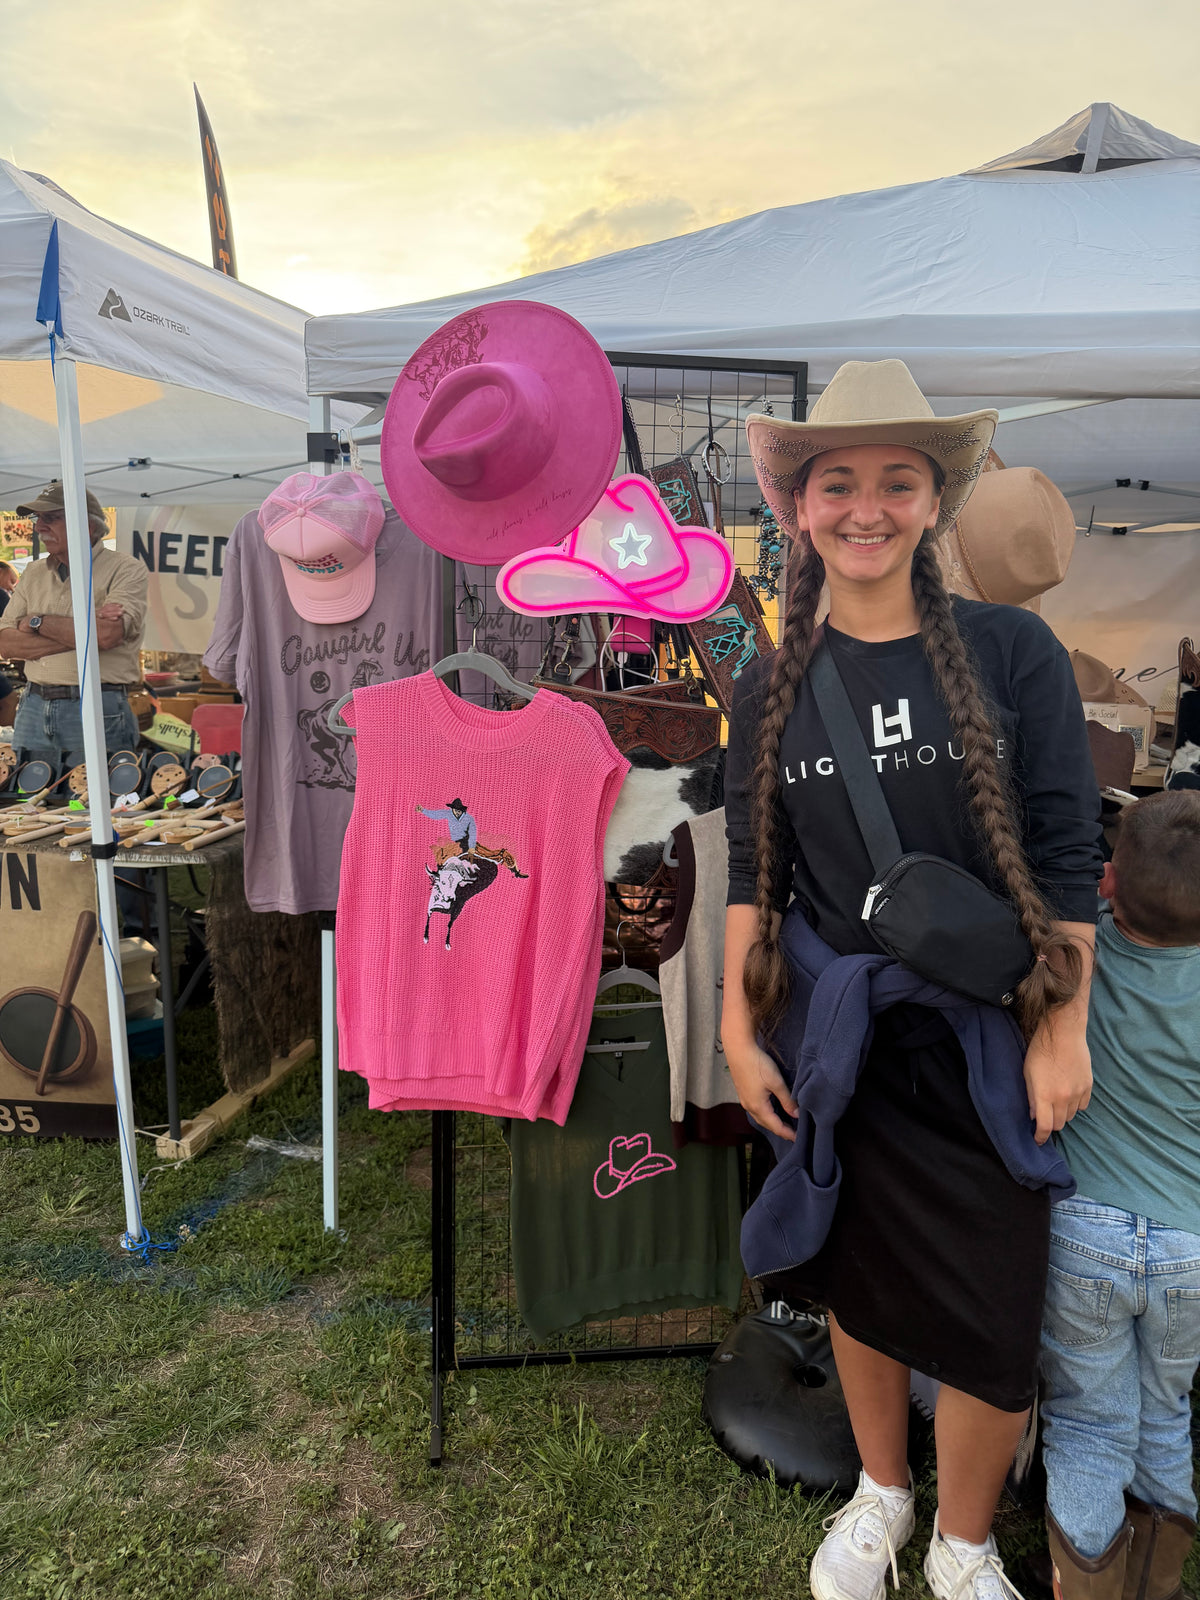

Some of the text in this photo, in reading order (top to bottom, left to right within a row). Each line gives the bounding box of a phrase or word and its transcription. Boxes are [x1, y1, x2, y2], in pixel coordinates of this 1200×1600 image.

[281, 621, 386, 676] Cowgirl
[785, 739, 1005, 784] LIGTHOUE
[0, 852, 41, 911] N
